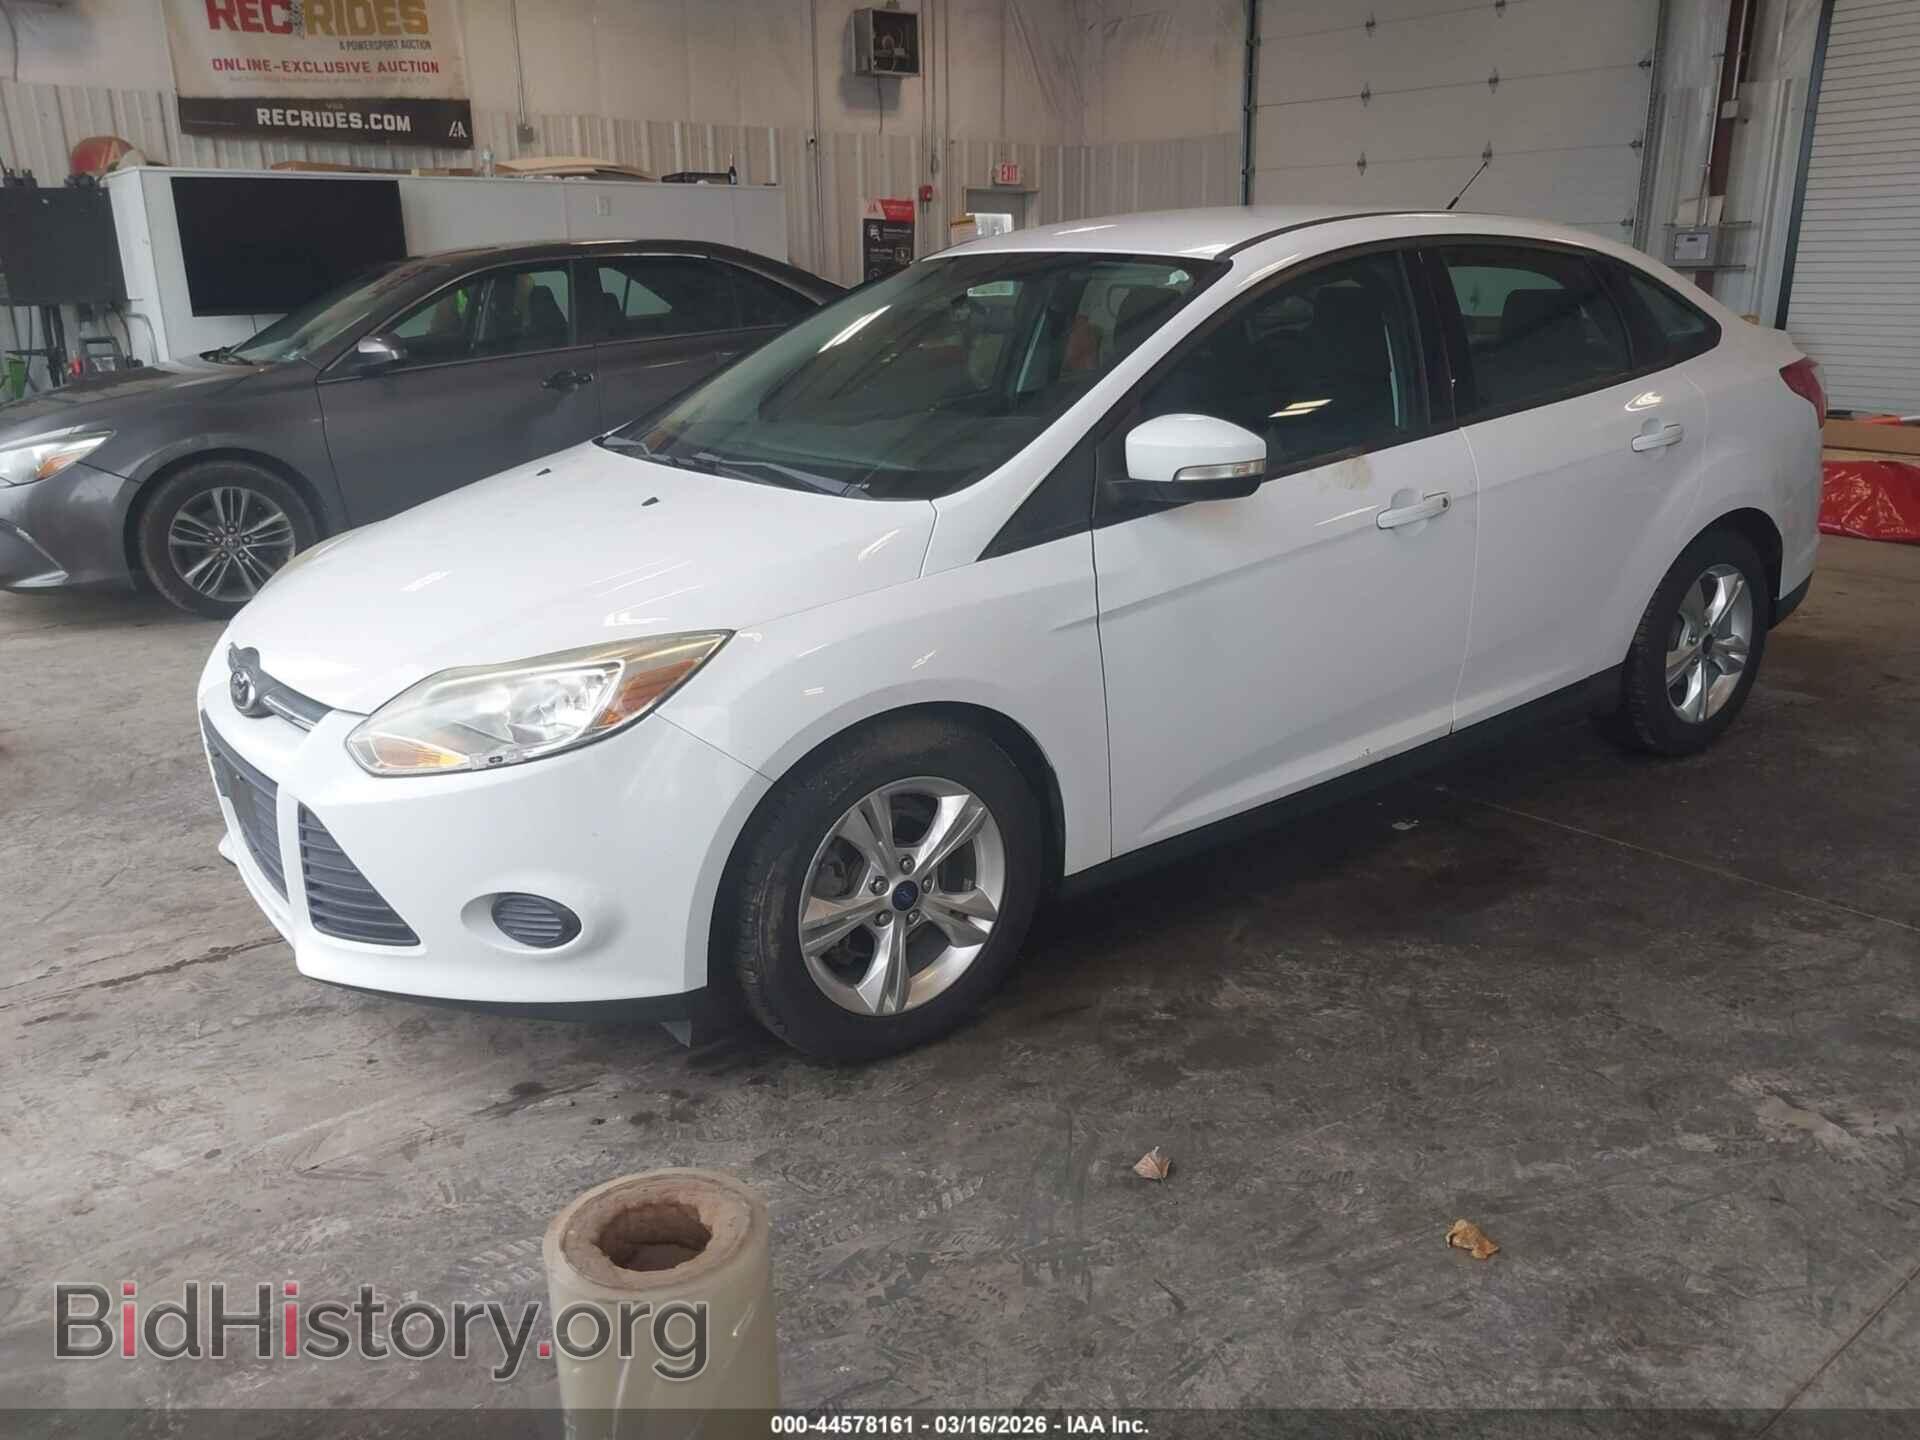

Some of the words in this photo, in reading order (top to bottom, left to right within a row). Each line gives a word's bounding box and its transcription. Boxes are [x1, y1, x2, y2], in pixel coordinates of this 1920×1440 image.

[205, 0, 294, 34] REC
[303, 0, 429, 37] RIDES
[400, 40, 431, 50] AUCTION
[212, 58, 370, 73] ONLINE-EXCLUSIVE
[378, 60, 439, 74] AUCTION
[256, 107, 412, 132] RECRIDES.COM
